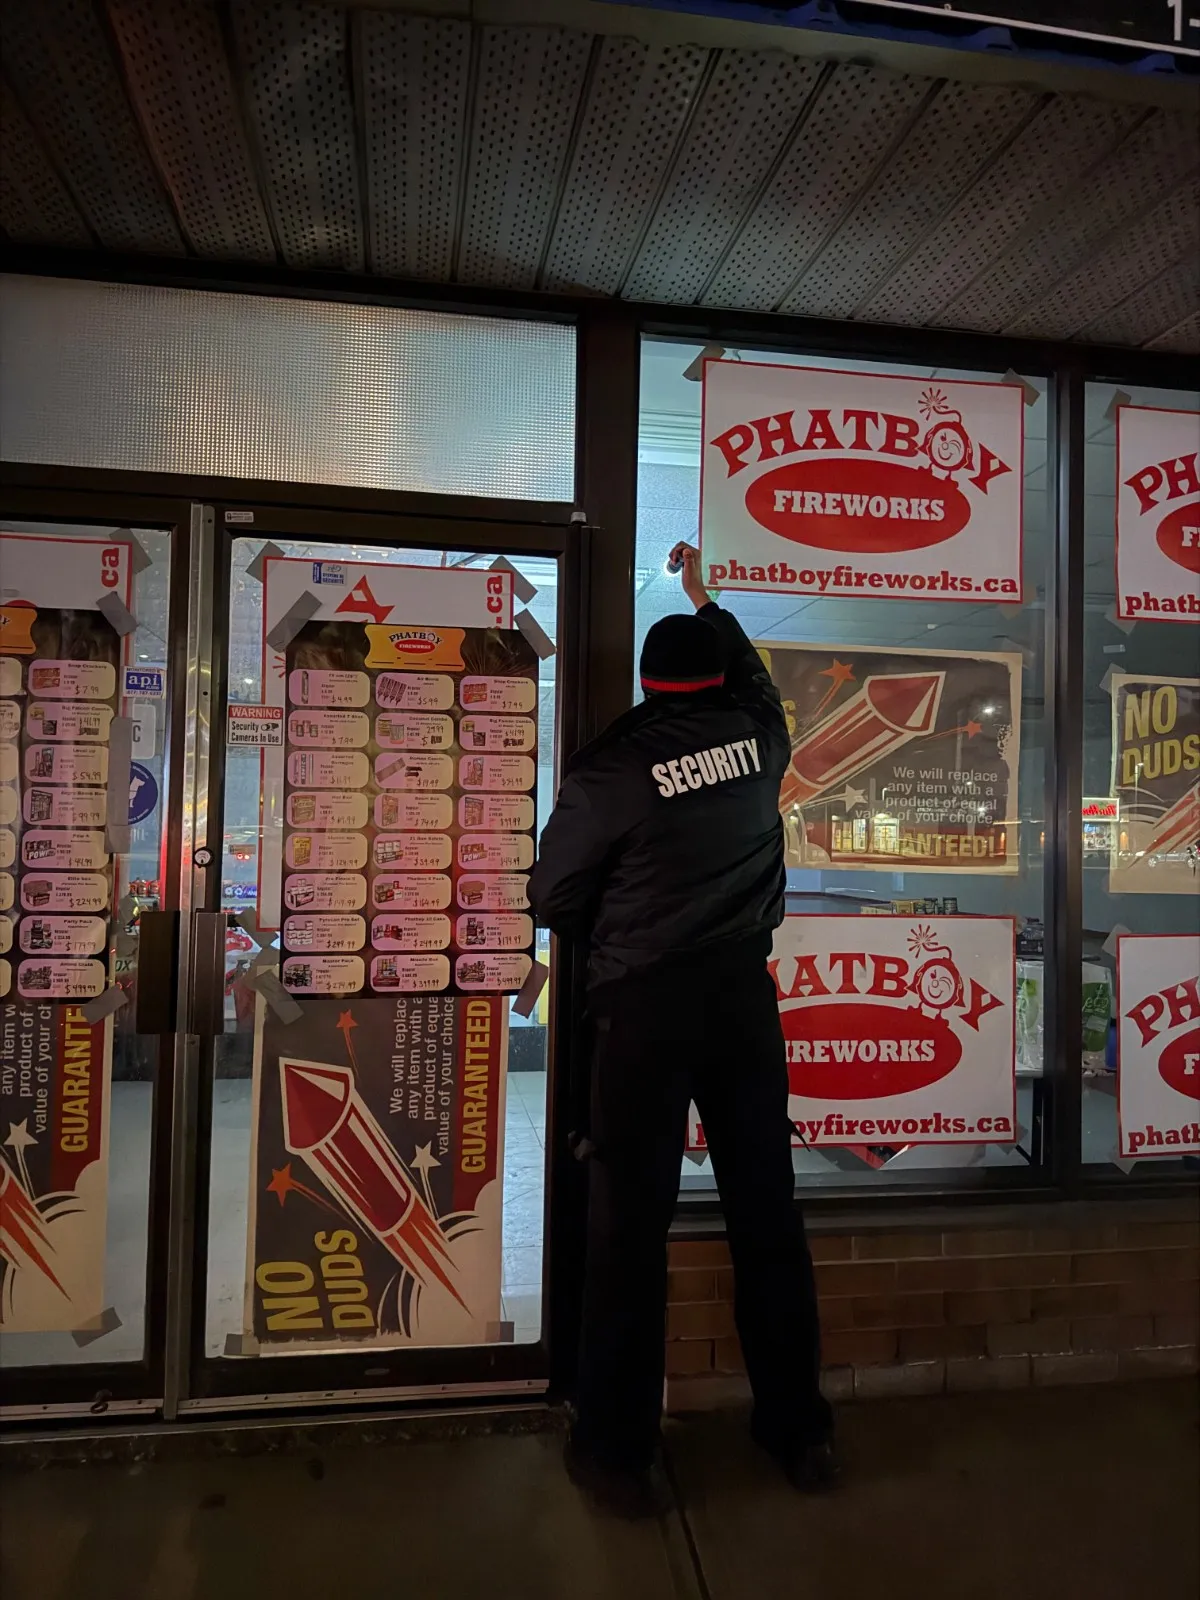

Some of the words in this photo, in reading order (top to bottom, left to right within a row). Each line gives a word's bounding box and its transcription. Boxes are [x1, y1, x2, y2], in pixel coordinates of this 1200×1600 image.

[710, 409, 1012, 496] PHATBOY
[773, 489, 945, 522] FIREWORKS
[708, 560, 1018, 595] phatboyfireworks.ca
[388, 631, 443, 645] PHATBOY
[231, 707, 281, 719] WARNING
[231, 721, 259, 733] Security
[1124, 685, 1178, 742] NO
[231, 732, 258, 742] Cameras
[260, 733, 267, 742] In
[267, 734, 280, 743] Use
[651, 737, 762, 799] SECURITY
[893, 766, 915, 779] We
[919, 767, 943, 780] will
[948, 769, 998, 782] replace
[1122, 734, 1200, 785] DUDS
[885, 795, 942, 807] product
[943, 798, 957, 807] of
[960, 799, 997, 811] equal
[887, 781, 913, 795] any
[916, 781, 947, 794] item
[952, 783, 981, 796] with
[985, 787, 994, 796] a
[855, 807, 893, 819] vale
[897, 809, 912, 821] of
[915, 812, 945, 824] your
[949, 811, 993, 825] choice
[874, 831, 995, 858] ANTEED!
[19, 1010, 34, 1028] of
[393, 998, 408, 1049] replac
[409, 1010, 422, 1046] with
[427, 997, 441, 1033] equa
[0, 1022, 16, 1060] item
[39, 1024, 53, 1062] your
[424, 1037, 437, 1054] of
[784, 1038, 936, 1063] IREWORKS
[1, 1064, 17, 1096] any
[17, 1032, 34, 1098] product
[34, 1065, 49, 1083] of
[60, 1006, 92, 1153] GUARANTE
[391, 1054, 405, 1086] will
[406, 1049, 420, 1087] item
[441, 1051, 454, 1087] your
[389, 1087, 404, 1114] We
[424, 1058, 437, 1121] product
[438, 1088, 451, 1106] of
[461, 997, 491, 1174] GUARANTEED
[33, 1087, 49, 1134] value
[408, 1088, 422, 1119] any
[436, 1112, 450, 1156] value
[791, 1112, 1013, 1143] oyfireworks.ca
[255, 1260, 324, 1332] NO
[313, 1228, 376, 1330] DUDS
